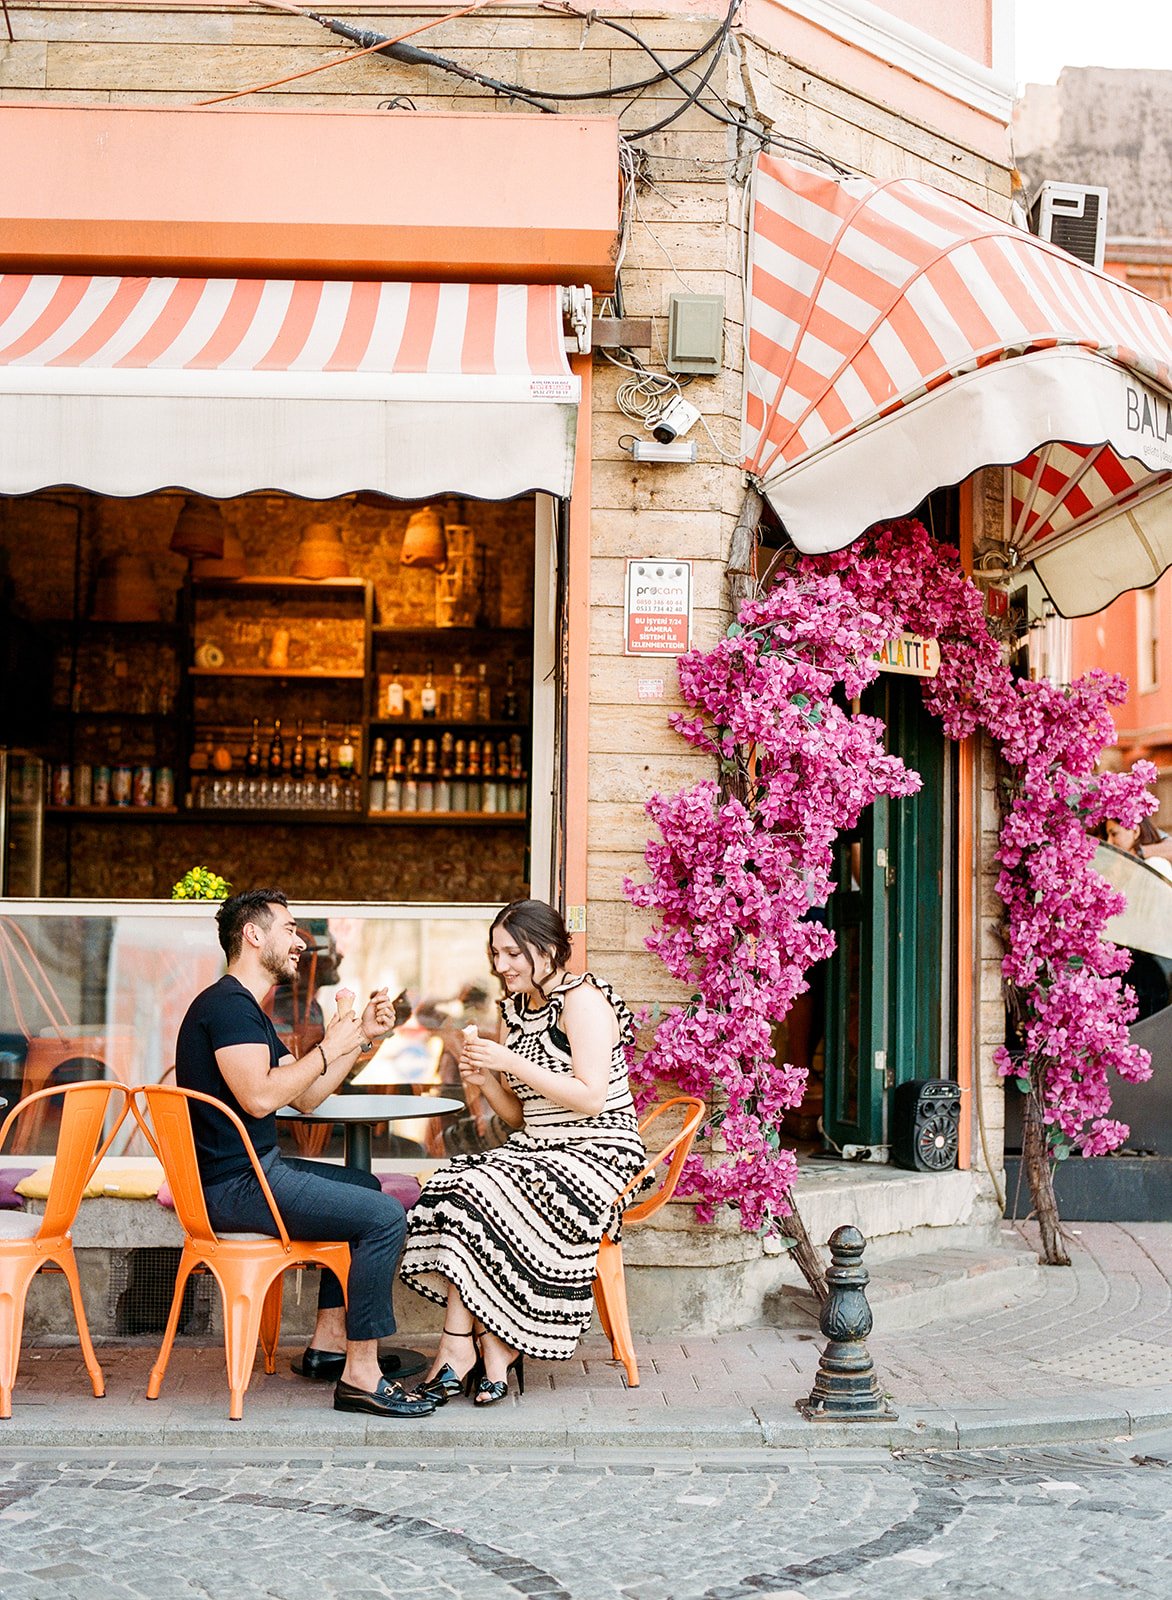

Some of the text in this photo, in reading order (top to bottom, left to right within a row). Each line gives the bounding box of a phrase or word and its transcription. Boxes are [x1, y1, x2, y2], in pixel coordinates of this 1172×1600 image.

[637, 587, 682, 596] procam
[646, 617, 668, 625] İŞYERİ
[639, 633, 677, 641] SİSTEMİ İLE
[632, 640, 684, 648] İZLENMEKTEDİR
